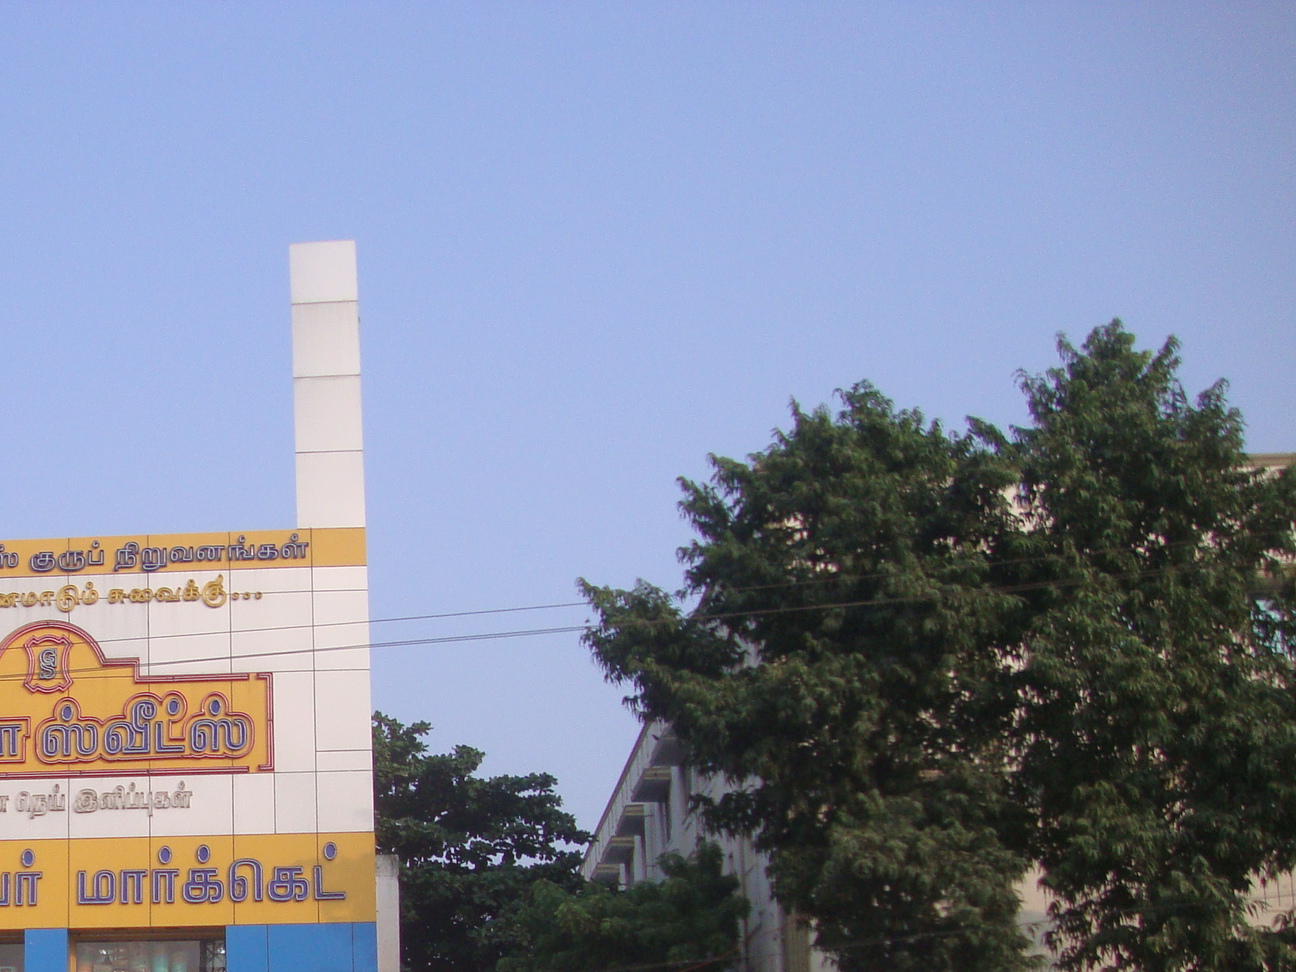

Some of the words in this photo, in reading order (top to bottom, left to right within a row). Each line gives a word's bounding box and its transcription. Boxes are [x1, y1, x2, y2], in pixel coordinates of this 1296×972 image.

[113, 532, 310, 572] நிறுவனங்கள்
[41, 697, 249, 757] ஸ்வீட்ஸ்
[15, 784, 66, 820] நெய்
[73, 780, 194, 817] இனிப்புகள்
[76, 841, 347, 905] மார்க்கெட்
